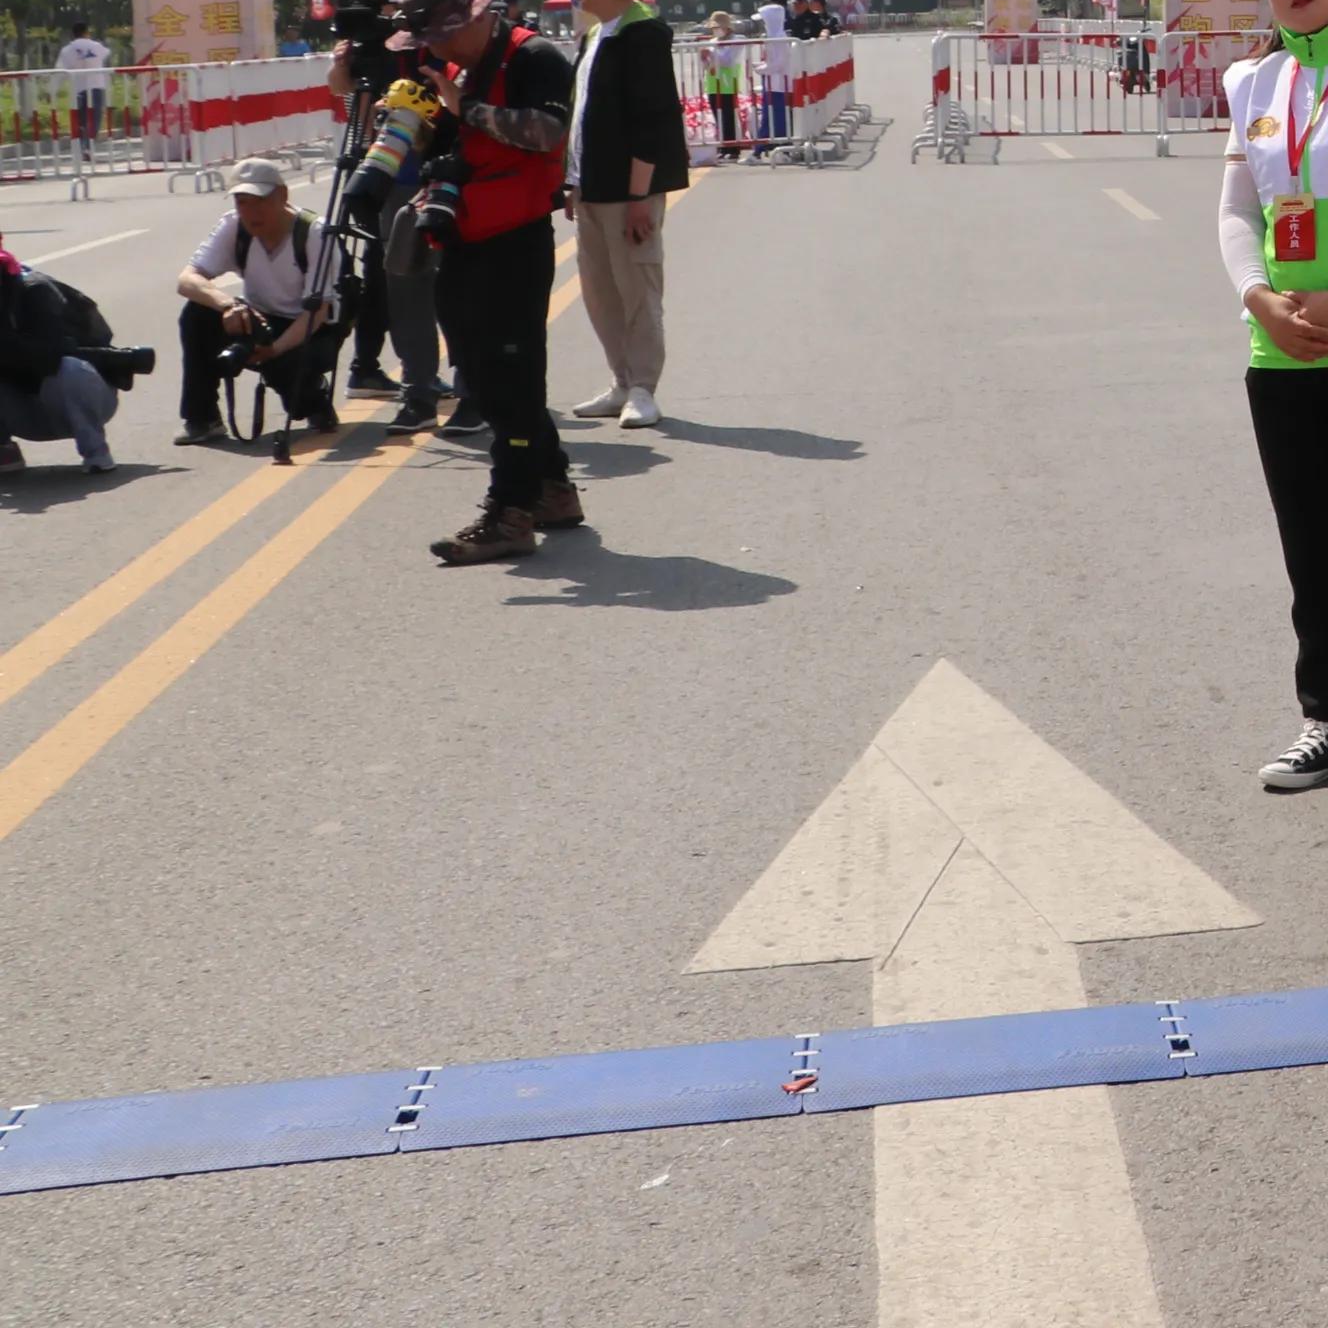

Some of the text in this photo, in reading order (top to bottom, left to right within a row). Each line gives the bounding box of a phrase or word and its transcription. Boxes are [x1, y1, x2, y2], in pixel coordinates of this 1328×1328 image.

[149, 2, 241, 37] 全程
[1289, 214, 1300, 248] 工作人员
